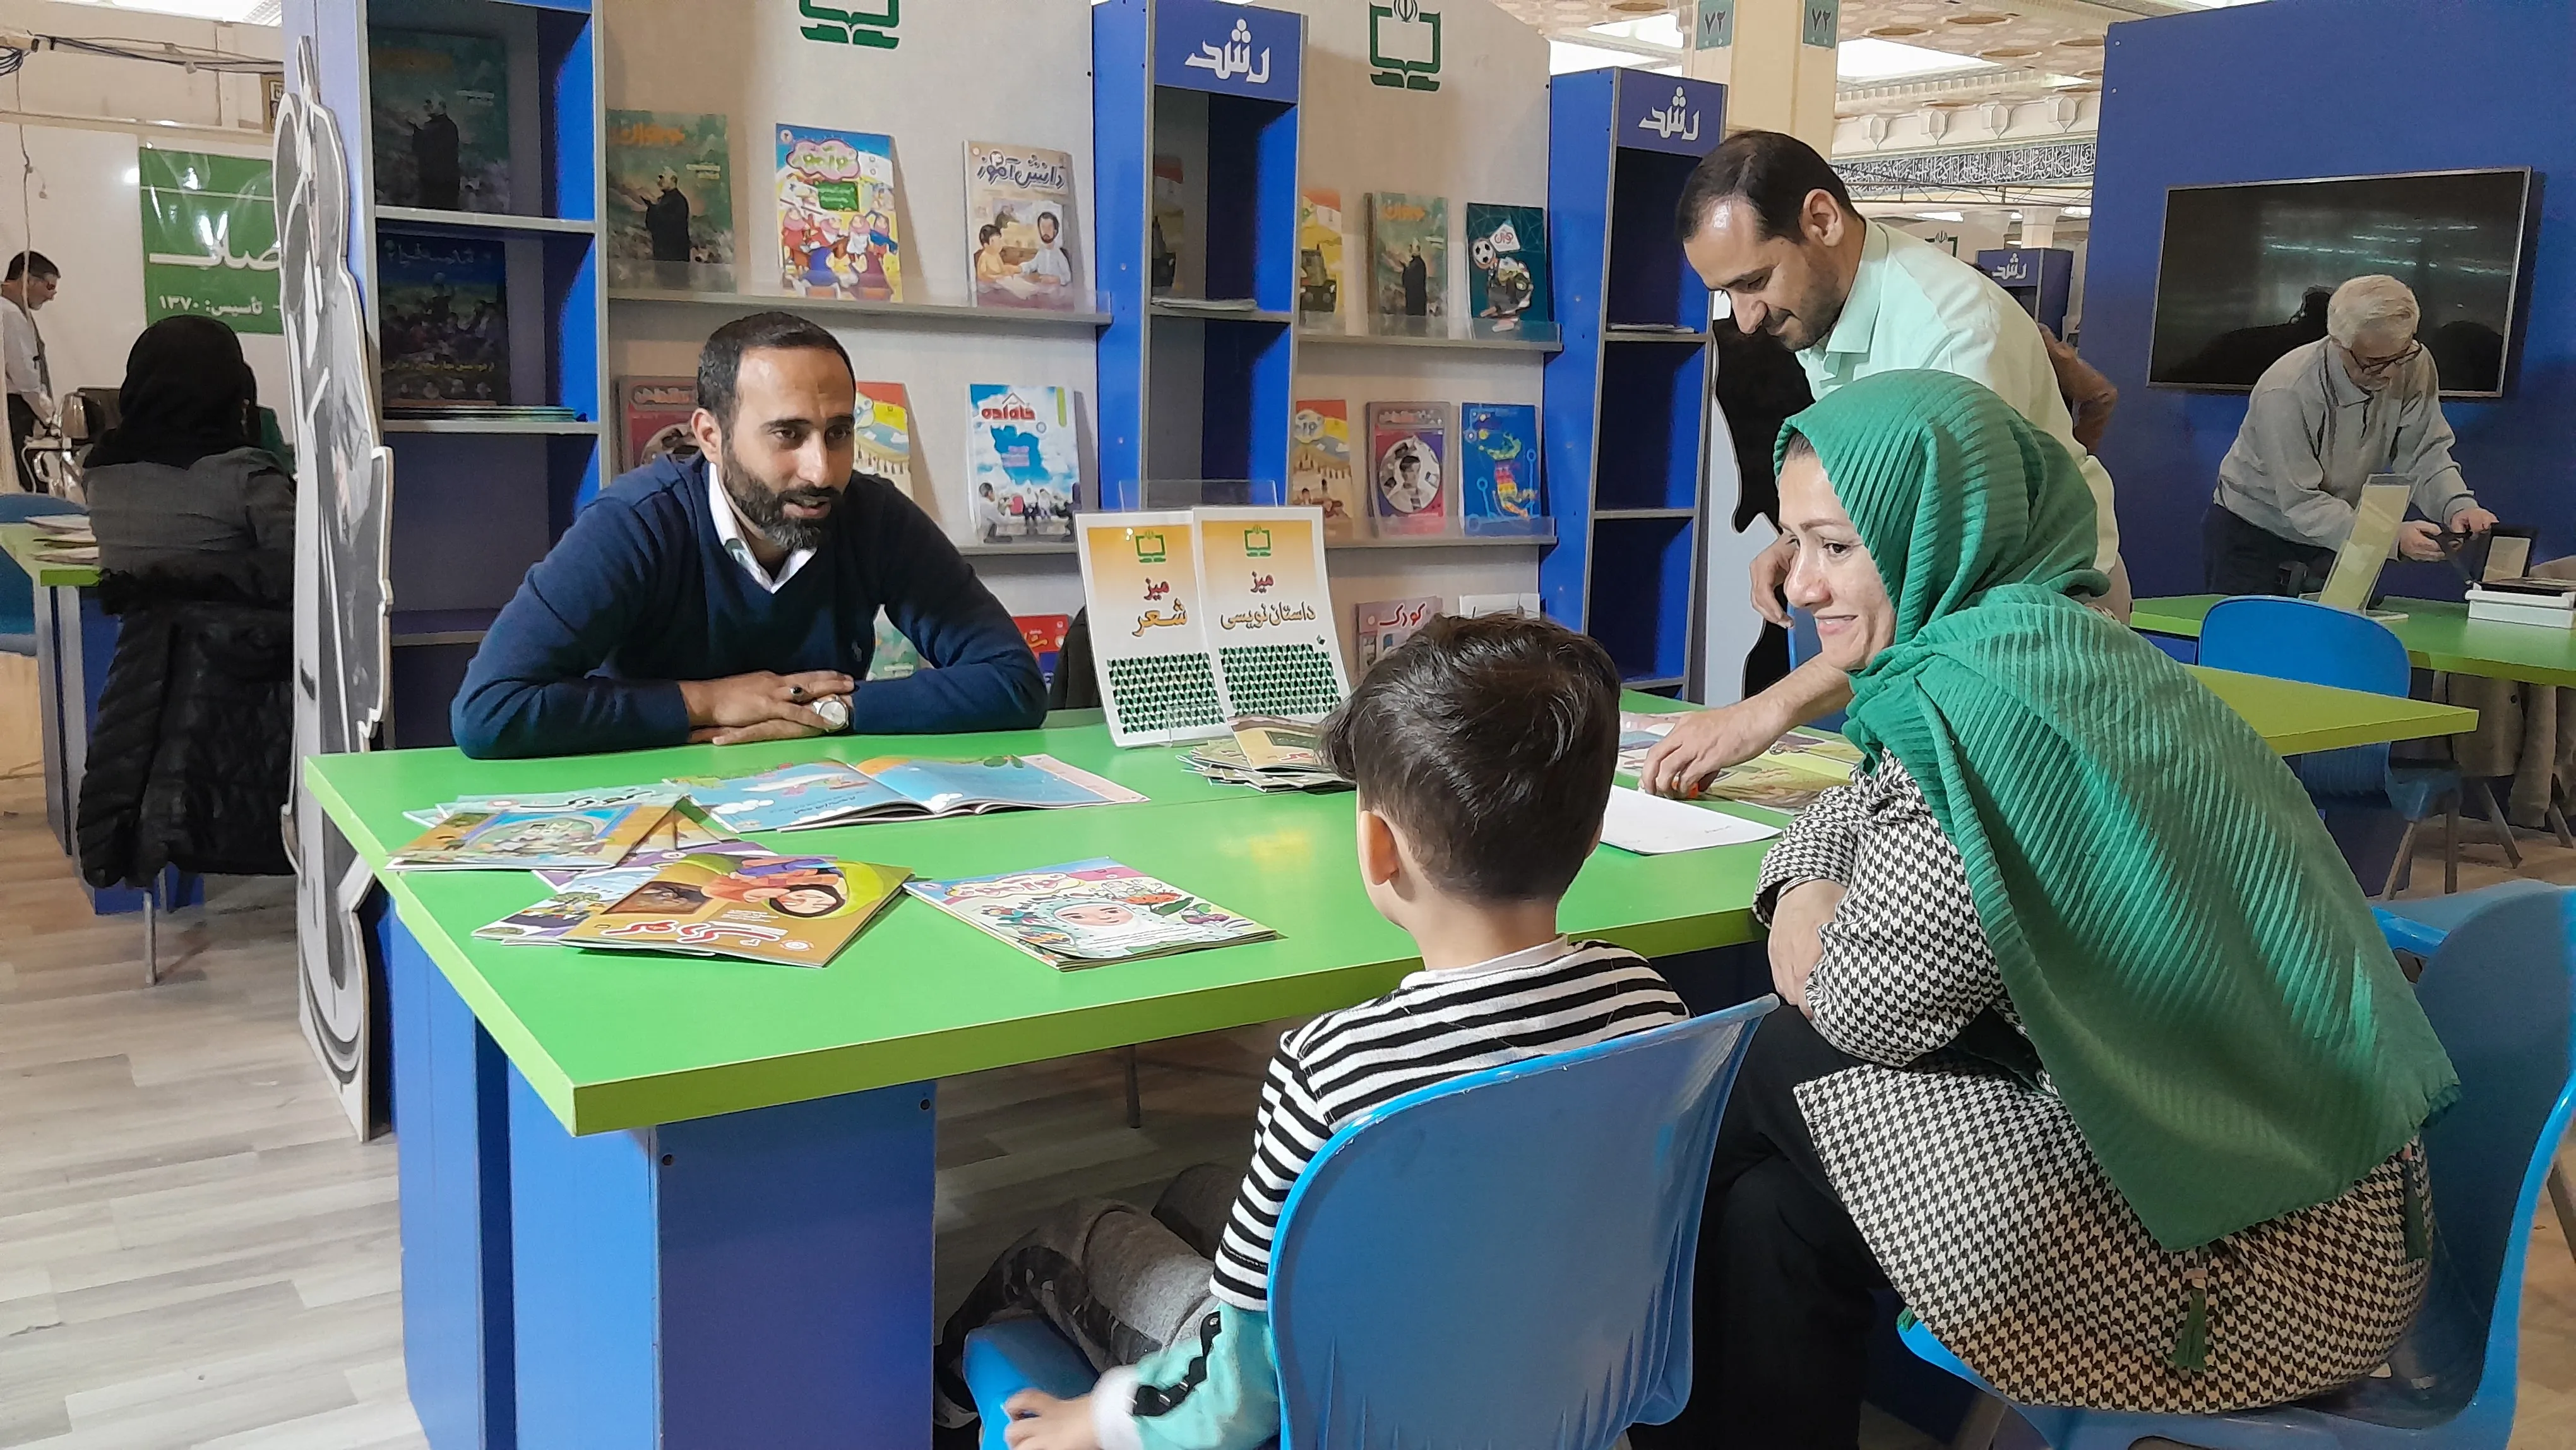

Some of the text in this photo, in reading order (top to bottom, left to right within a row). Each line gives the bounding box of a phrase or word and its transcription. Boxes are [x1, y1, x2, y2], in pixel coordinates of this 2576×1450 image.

[1184, 18, 1270, 83] رشد
[1638, 85, 1700, 141] رشد
[1991, 252, 2027, 280] رشد
[159, 294, 200, 311] ۱۳۷۰
[1143, 577, 1169, 601] میز
[1249, 570, 1274, 594] میز
[1131, 597, 1188, 637] شعر
[1379, 602, 1426, 626] کودک
[600, 920, 780, 944] کودک
